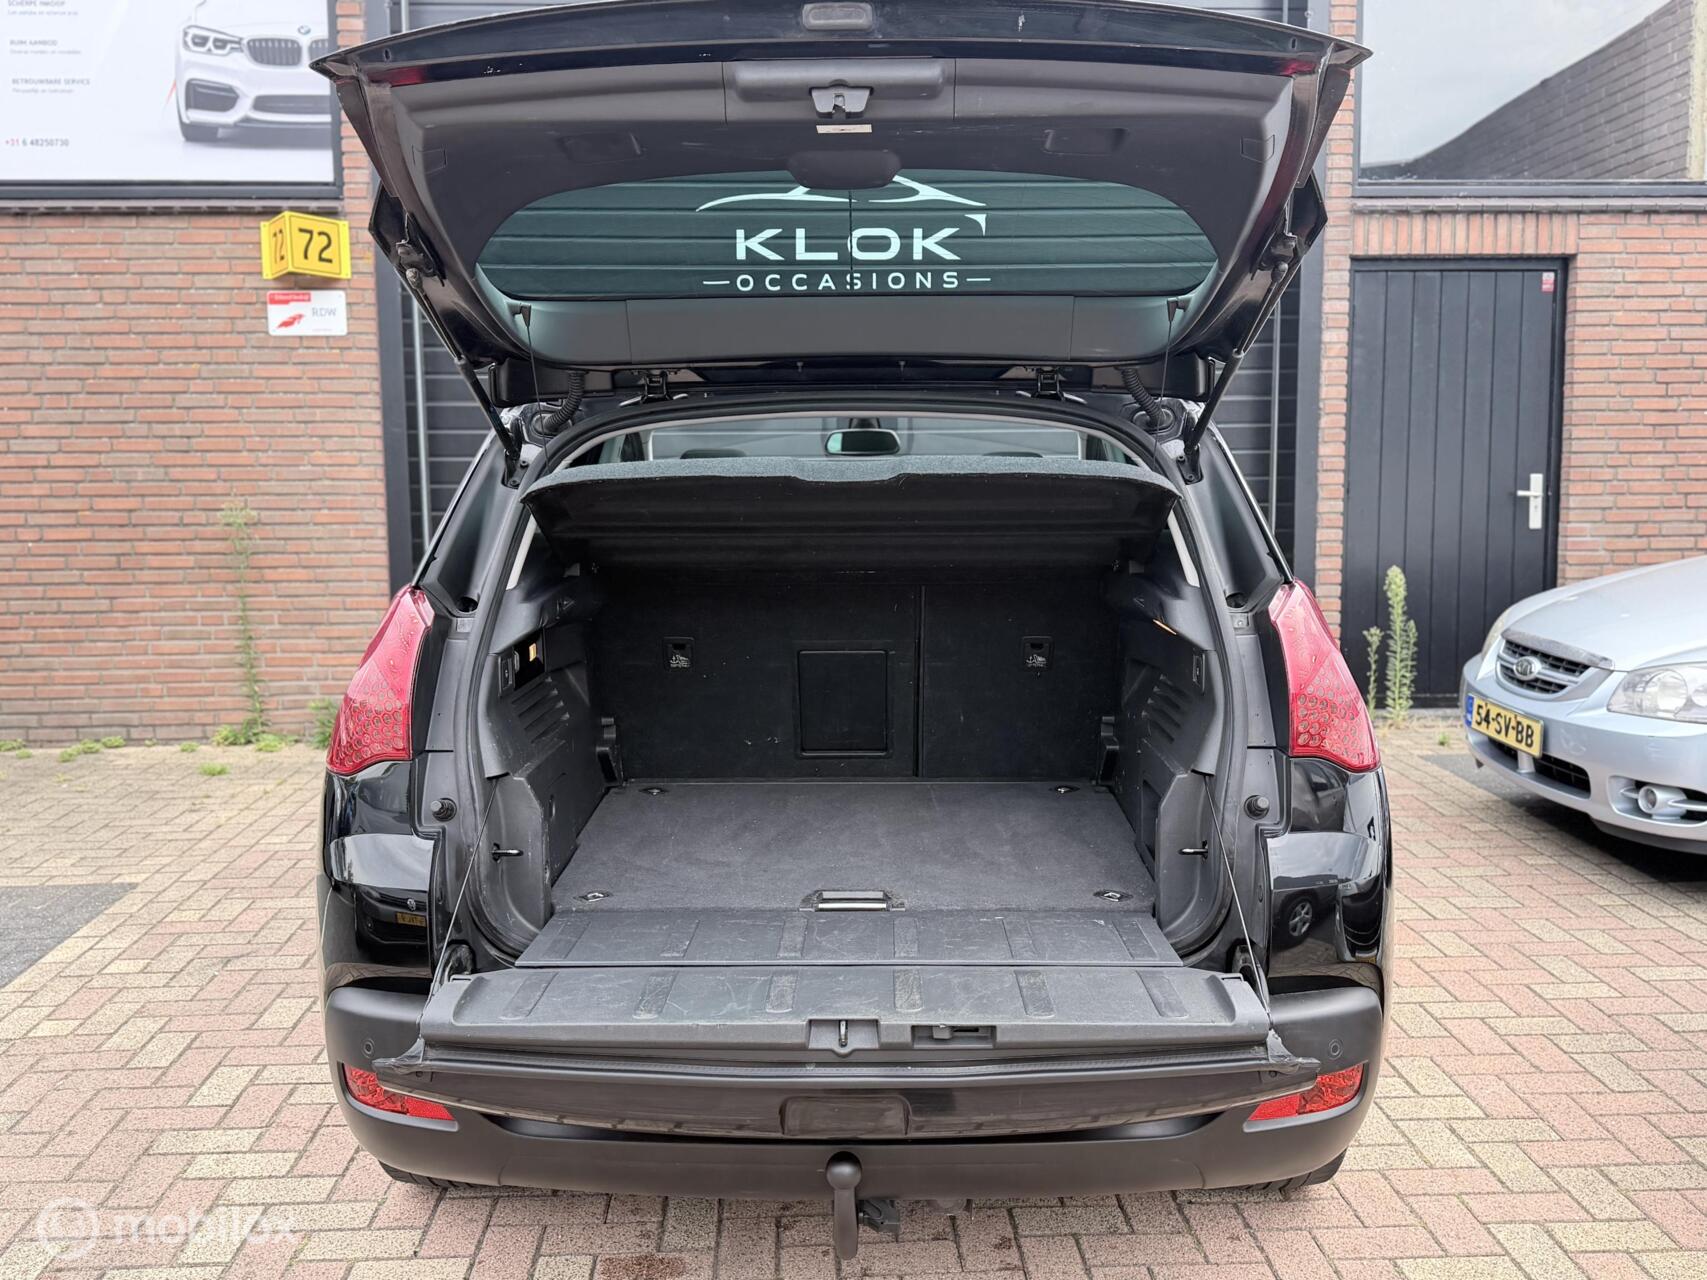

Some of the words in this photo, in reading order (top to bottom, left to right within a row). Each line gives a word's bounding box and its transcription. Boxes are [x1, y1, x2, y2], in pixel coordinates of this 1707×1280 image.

[22, 138, 28, 147] 6
[298, 227, 334, 264] 72
[735, 227, 961, 261] KLOK
[736, 271, 959, 292] OCCASIONS
[311, 306, 337, 318] RDW
[1475, 703, 1535, 749] 54-SV-BB
